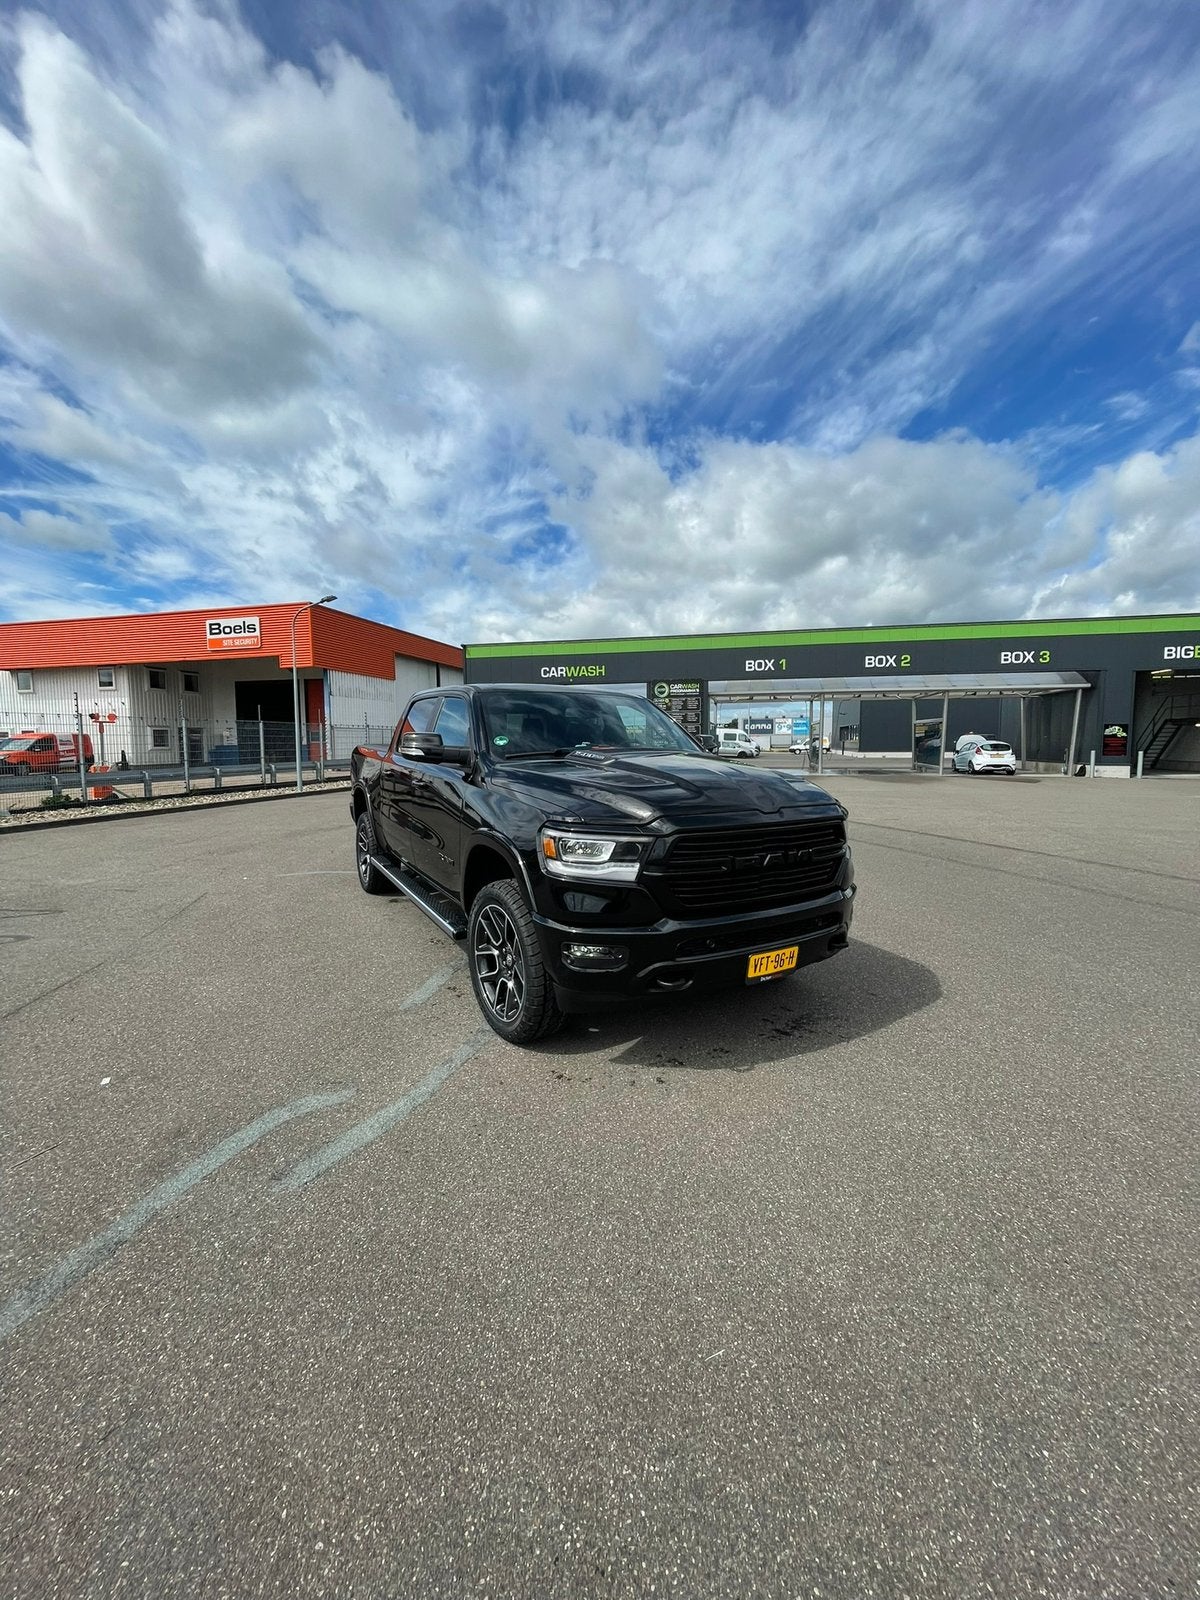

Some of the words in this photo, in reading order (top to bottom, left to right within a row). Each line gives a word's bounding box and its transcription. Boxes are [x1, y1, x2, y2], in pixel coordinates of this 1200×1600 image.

[209, 621, 256, 635] Boels
[234, 638, 258, 646] SECURITY
[864, 655, 897, 668] BOX
[900, 654, 911, 667] 2
[1000, 651, 1035, 664] BOX
[1039, 650, 1050, 663] 3
[540, 665, 606, 678] CARWASH
[745, 659, 775, 672] BOX
[779, 659, 787, 670] 1
[753, 950, 795, 974] VFT-96-H
